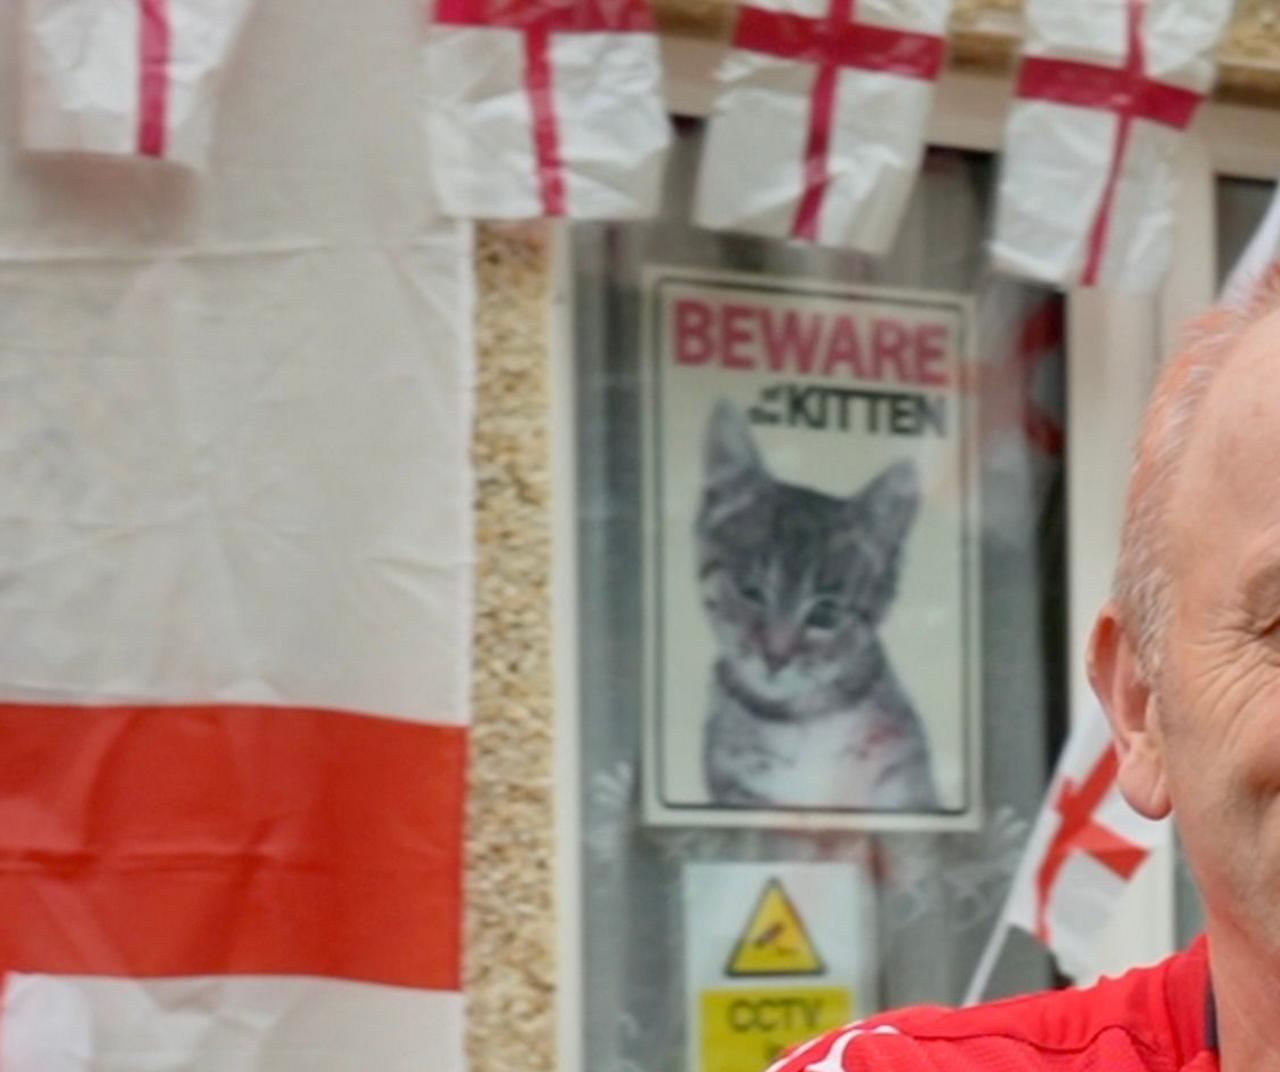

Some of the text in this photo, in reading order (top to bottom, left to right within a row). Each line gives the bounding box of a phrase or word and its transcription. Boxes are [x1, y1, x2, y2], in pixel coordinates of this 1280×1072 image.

[674, 299, 949, 386] BEWARE
[787, 384, 947, 437] KITTEN
[728, 996, 823, 1033] CCTV
